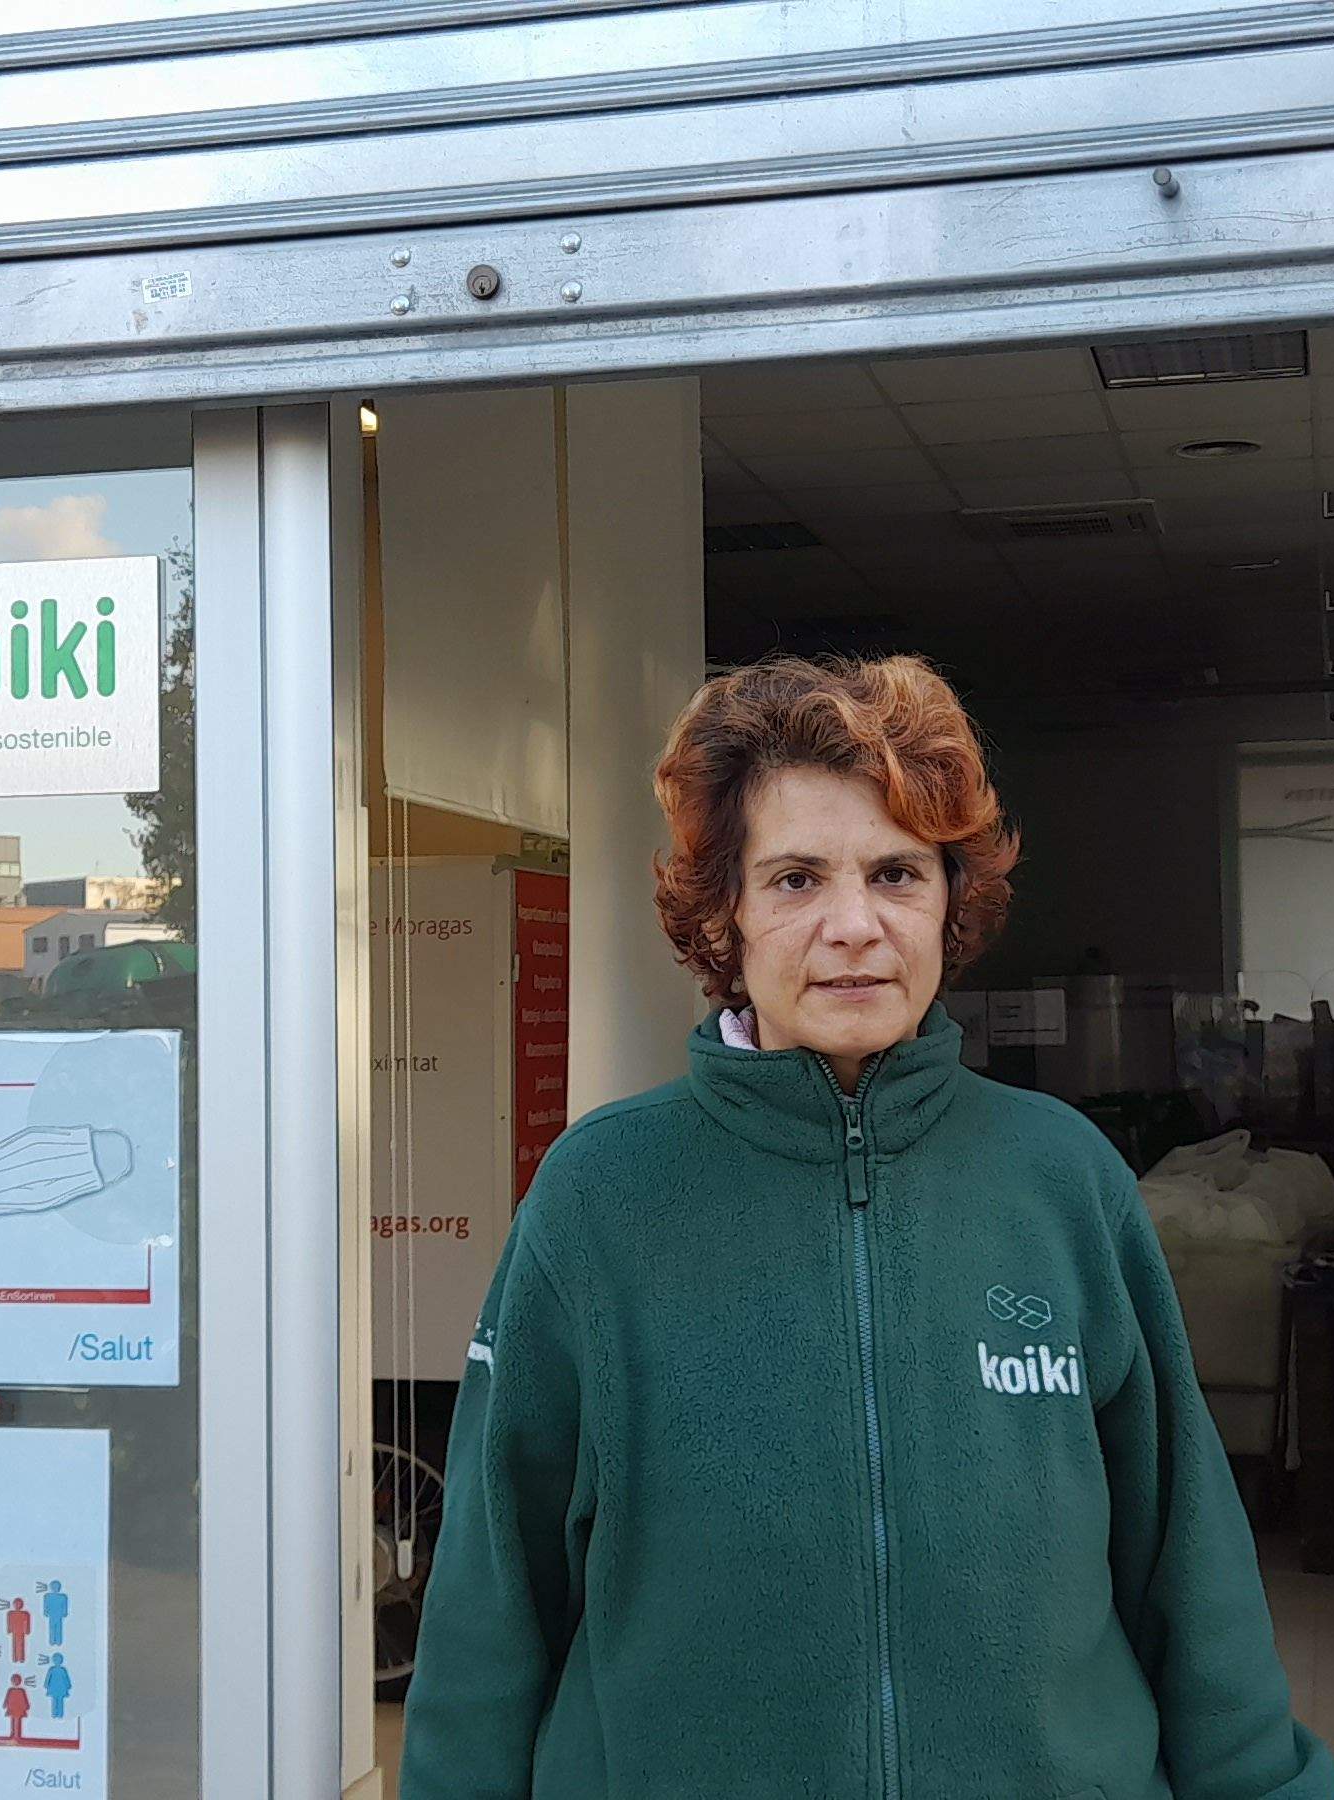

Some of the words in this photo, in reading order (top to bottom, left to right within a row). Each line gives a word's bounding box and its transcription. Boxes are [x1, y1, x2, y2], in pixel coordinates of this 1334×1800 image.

[385, 916, 473, 940] Moragas
[370, 1215, 469, 1239] agas.org
[977, 1341, 1081, 1396] koiki
